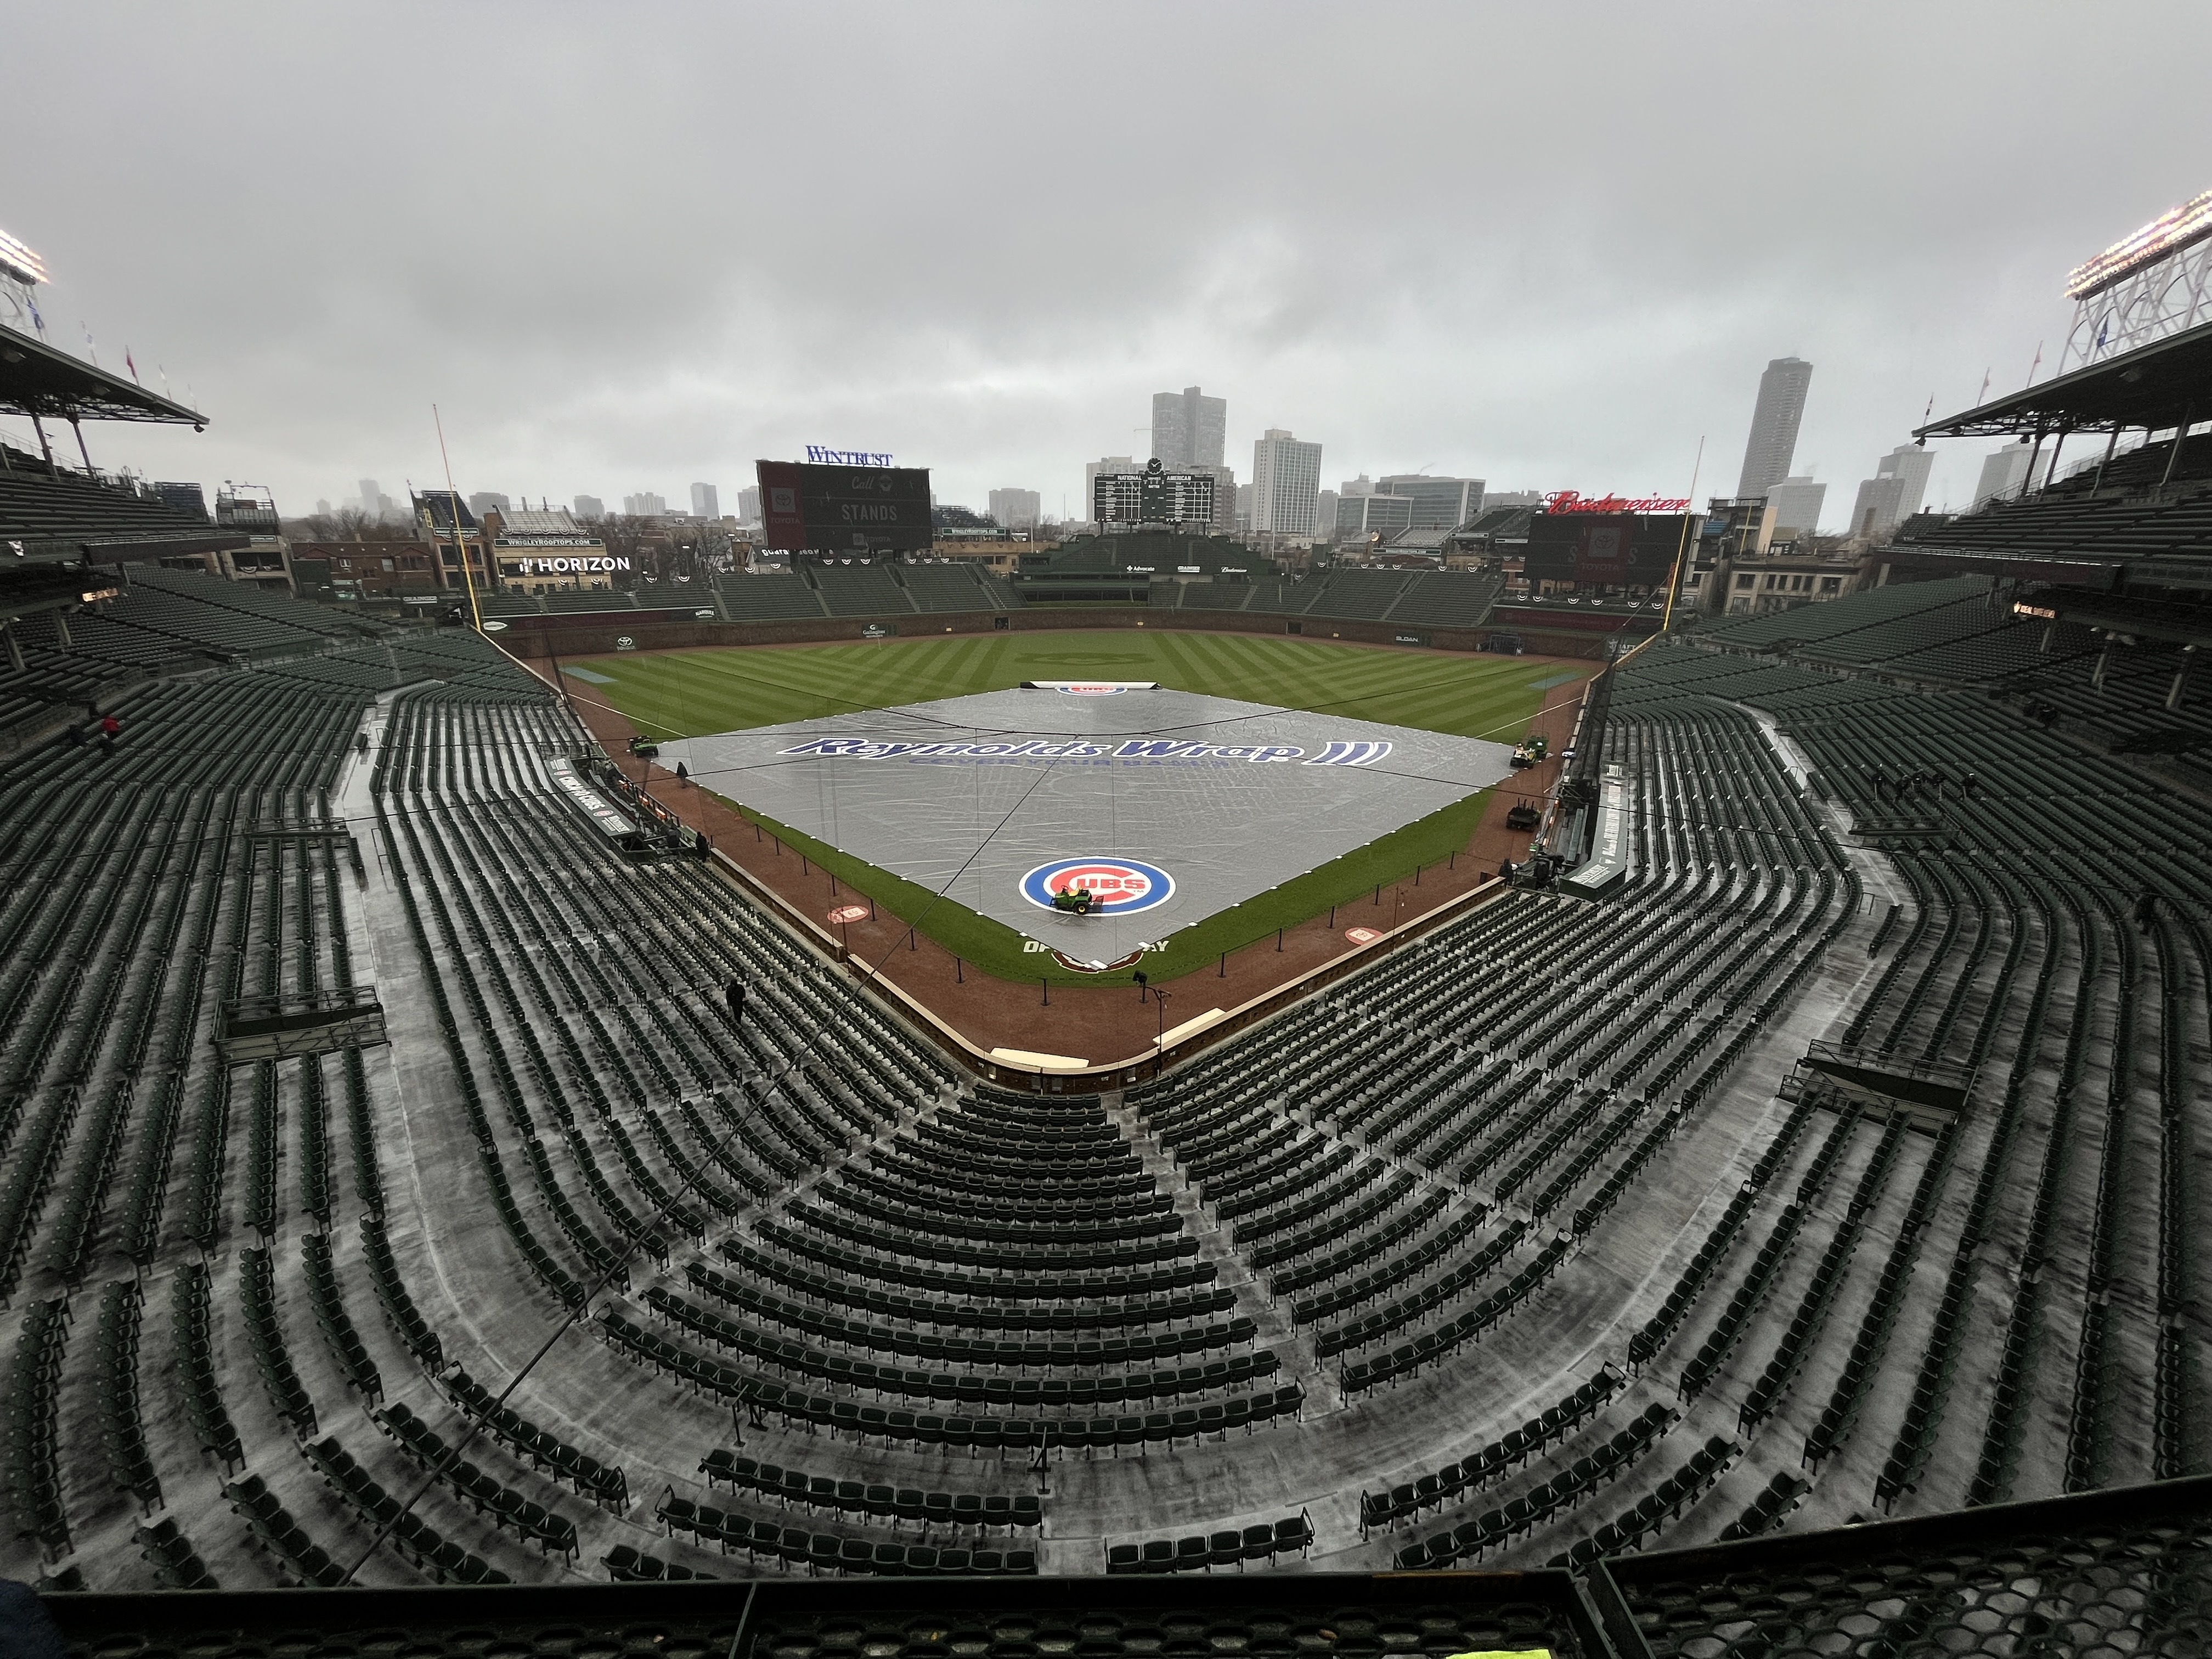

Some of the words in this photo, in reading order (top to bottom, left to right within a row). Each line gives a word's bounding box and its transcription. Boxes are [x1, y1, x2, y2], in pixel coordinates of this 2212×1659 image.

[852, 476, 875, 490] Call
[1545, 490, 1691, 515] Budweiser
[842, 504, 898, 521] STANDS
[538, 556, 631, 572] HORIZON
[1581, 562, 1620, 571] TOYOTA
[775, 738, 1114, 759] Reynolds
[1111, 740, 1306, 763] Wrap
[1050, 867, 1146, 904] CUBS
[1143, 940, 1170, 952] AY
